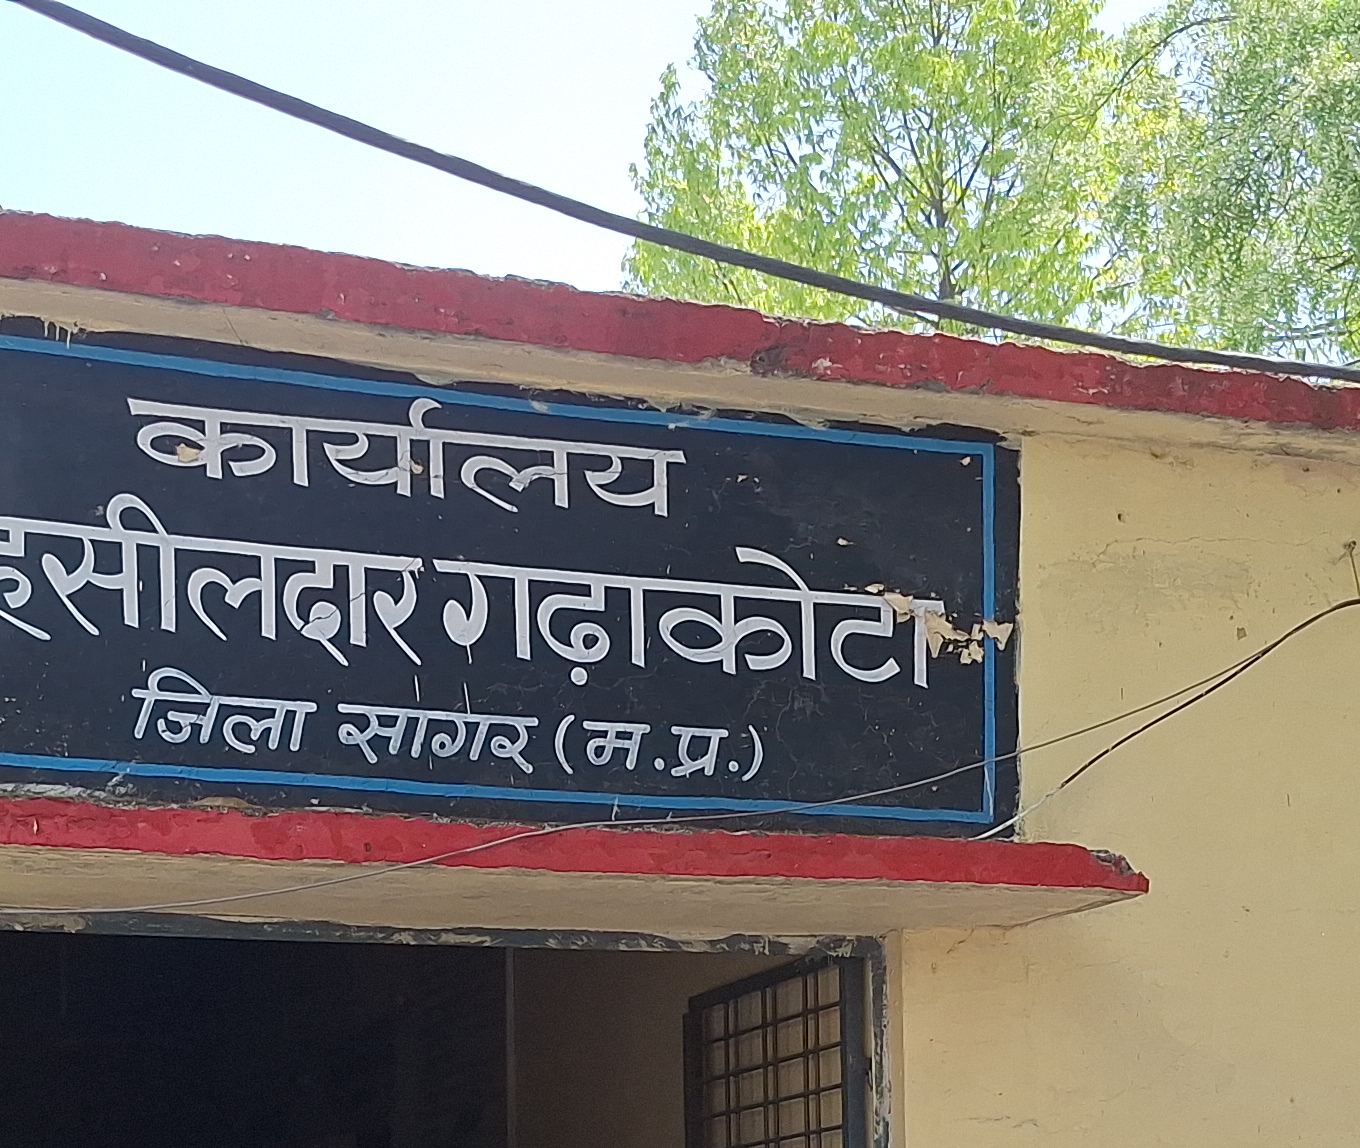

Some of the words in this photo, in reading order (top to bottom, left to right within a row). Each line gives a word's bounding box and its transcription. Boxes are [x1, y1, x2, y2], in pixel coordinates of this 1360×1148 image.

[128, 396, 686, 516] कार्यालय
[436, 546, 946, 688] गढ़ाकोटा
[131, 667, 317, 753] जिला
[338, 701, 541, 777] सागर
